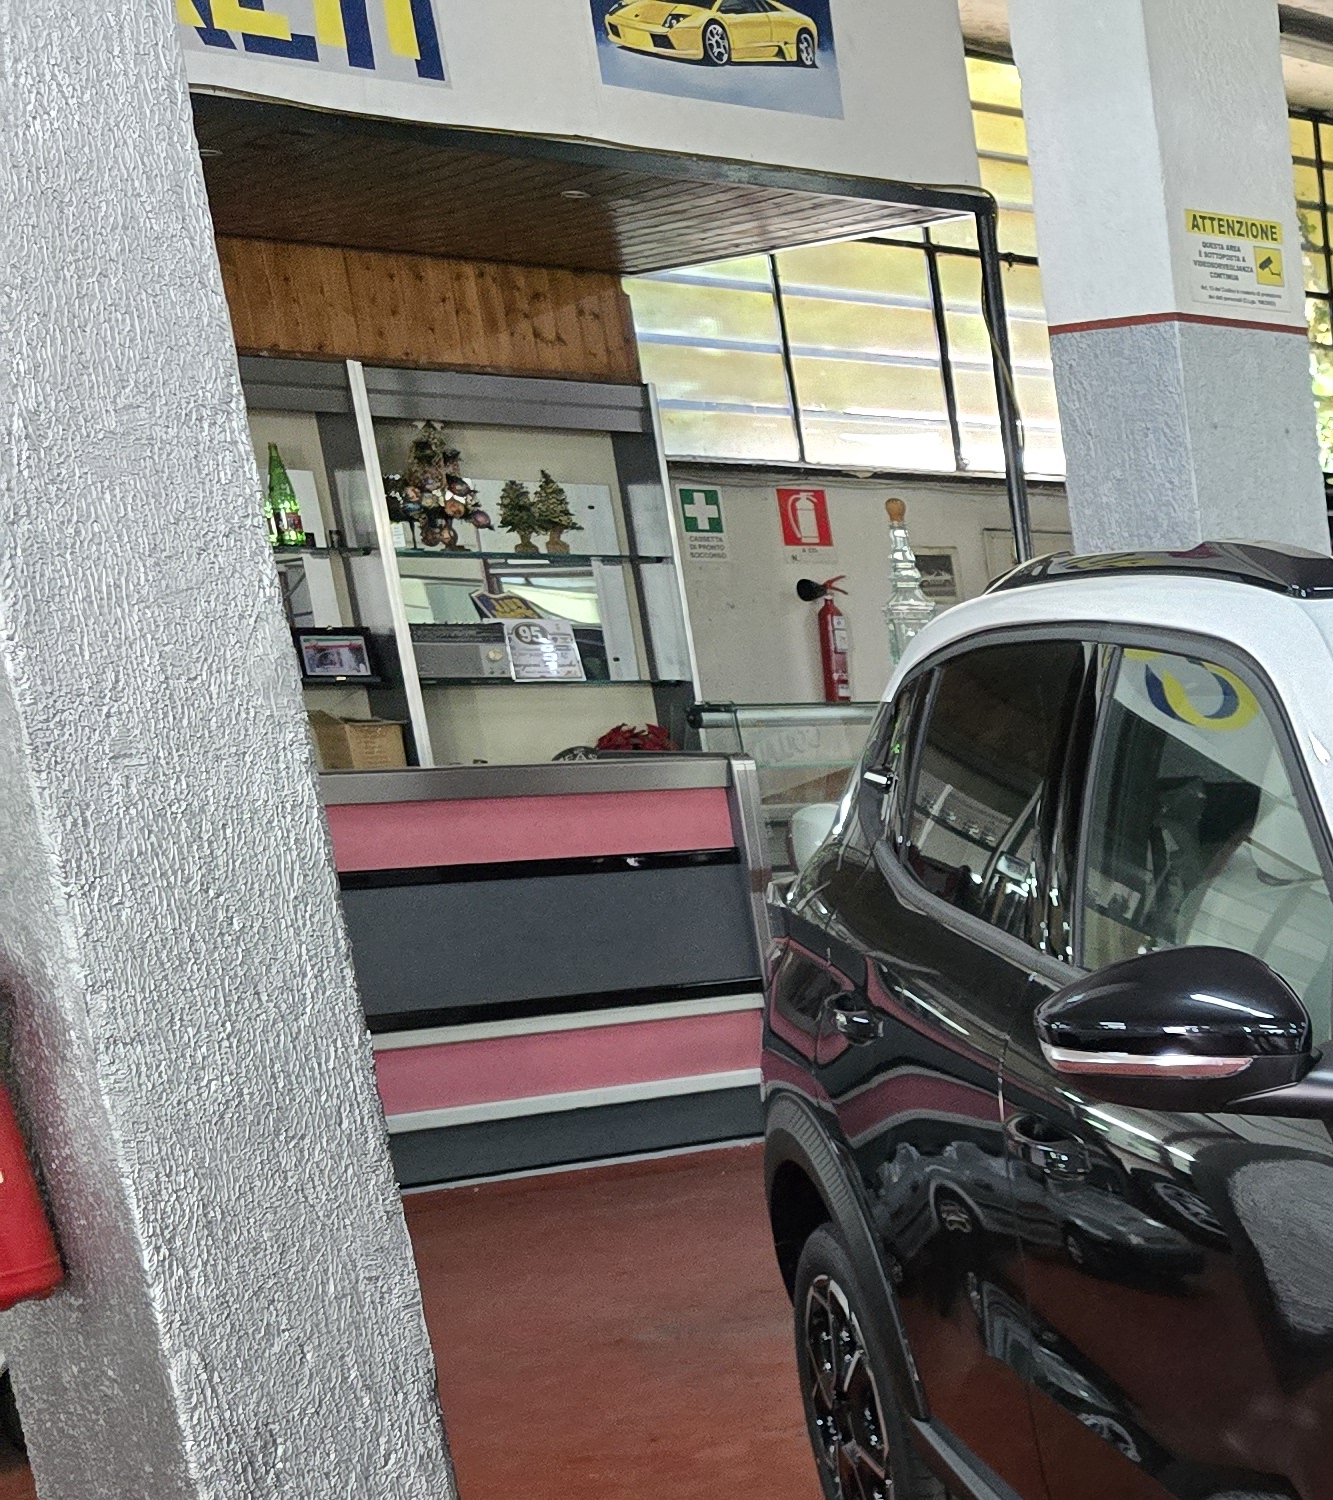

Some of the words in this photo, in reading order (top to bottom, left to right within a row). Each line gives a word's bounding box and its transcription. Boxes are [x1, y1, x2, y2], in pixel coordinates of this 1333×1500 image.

[1191, 213, 1279, 242] ATTENZIONE
[1202, 241, 1225, 250] QUESTA
[1226, 244, 1241, 253] AREA
[518, 625, 543, 643] 95
